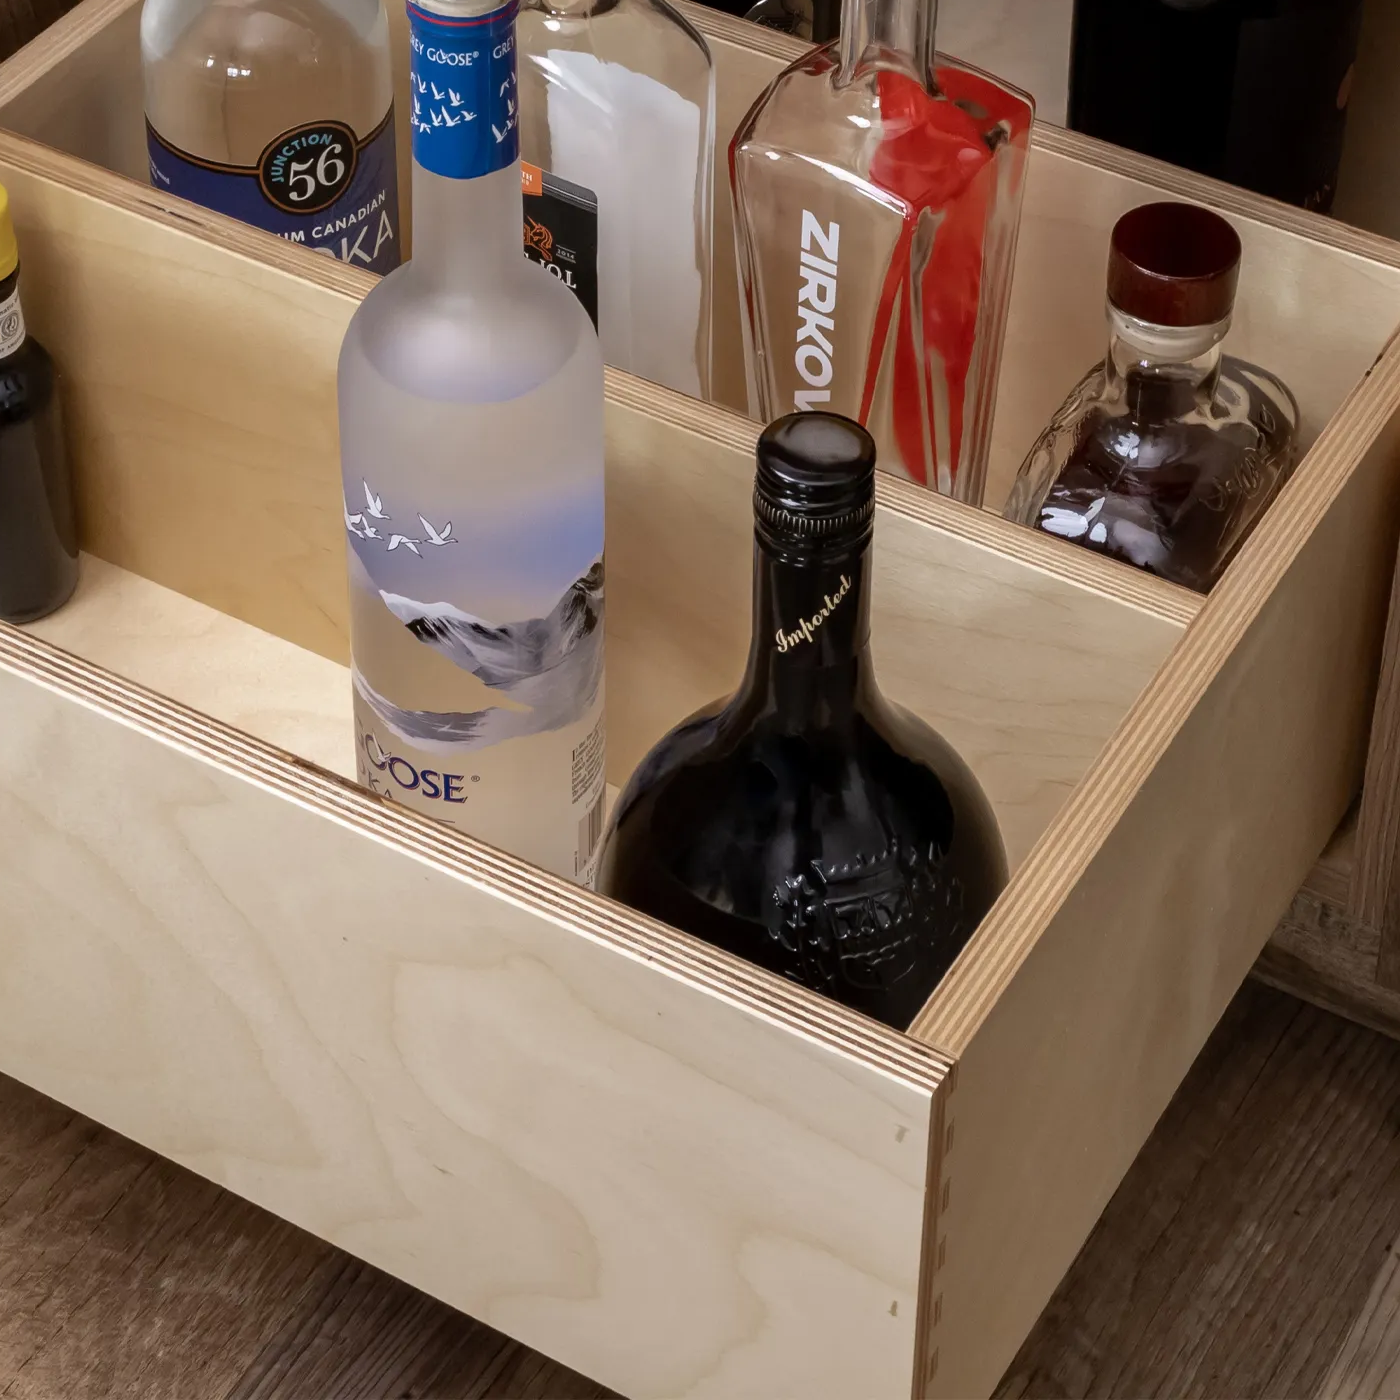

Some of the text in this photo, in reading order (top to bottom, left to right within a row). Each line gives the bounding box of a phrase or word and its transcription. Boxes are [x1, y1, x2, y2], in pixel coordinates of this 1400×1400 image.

[410, 29, 473, 66] REY GOOSE
[271, 133, 333, 183] JUNCTION
[288, 143, 345, 201] 56
[312, 190, 386, 239] CANADIAN
[776, 574, 851, 653] Imported
[357, 716, 468, 804] OOSE
